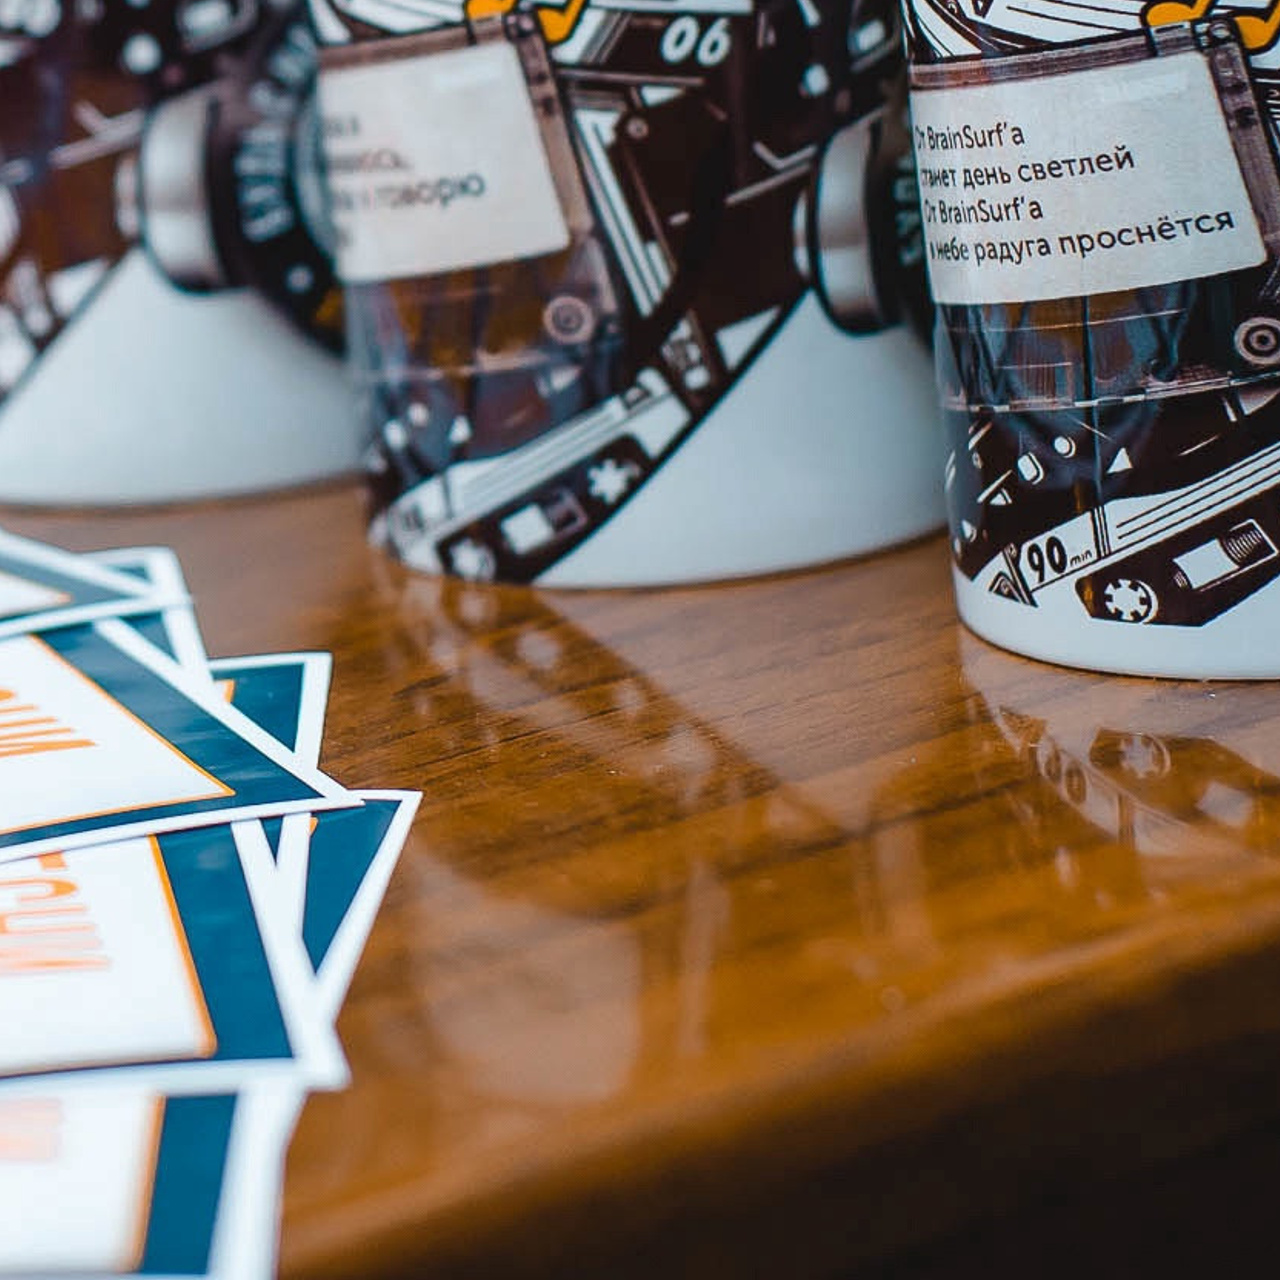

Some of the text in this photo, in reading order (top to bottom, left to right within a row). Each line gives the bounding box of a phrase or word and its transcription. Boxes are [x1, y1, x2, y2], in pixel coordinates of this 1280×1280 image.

[660, 16, 731, 67] 06
[963, 166, 1011, 190] день
[1018, 145, 1135, 183] светлей
[975, 237, 1052, 268] радуга
[1060, 210, 1235, 258] проснётся
[1027, 535, 1068, 584] 90
